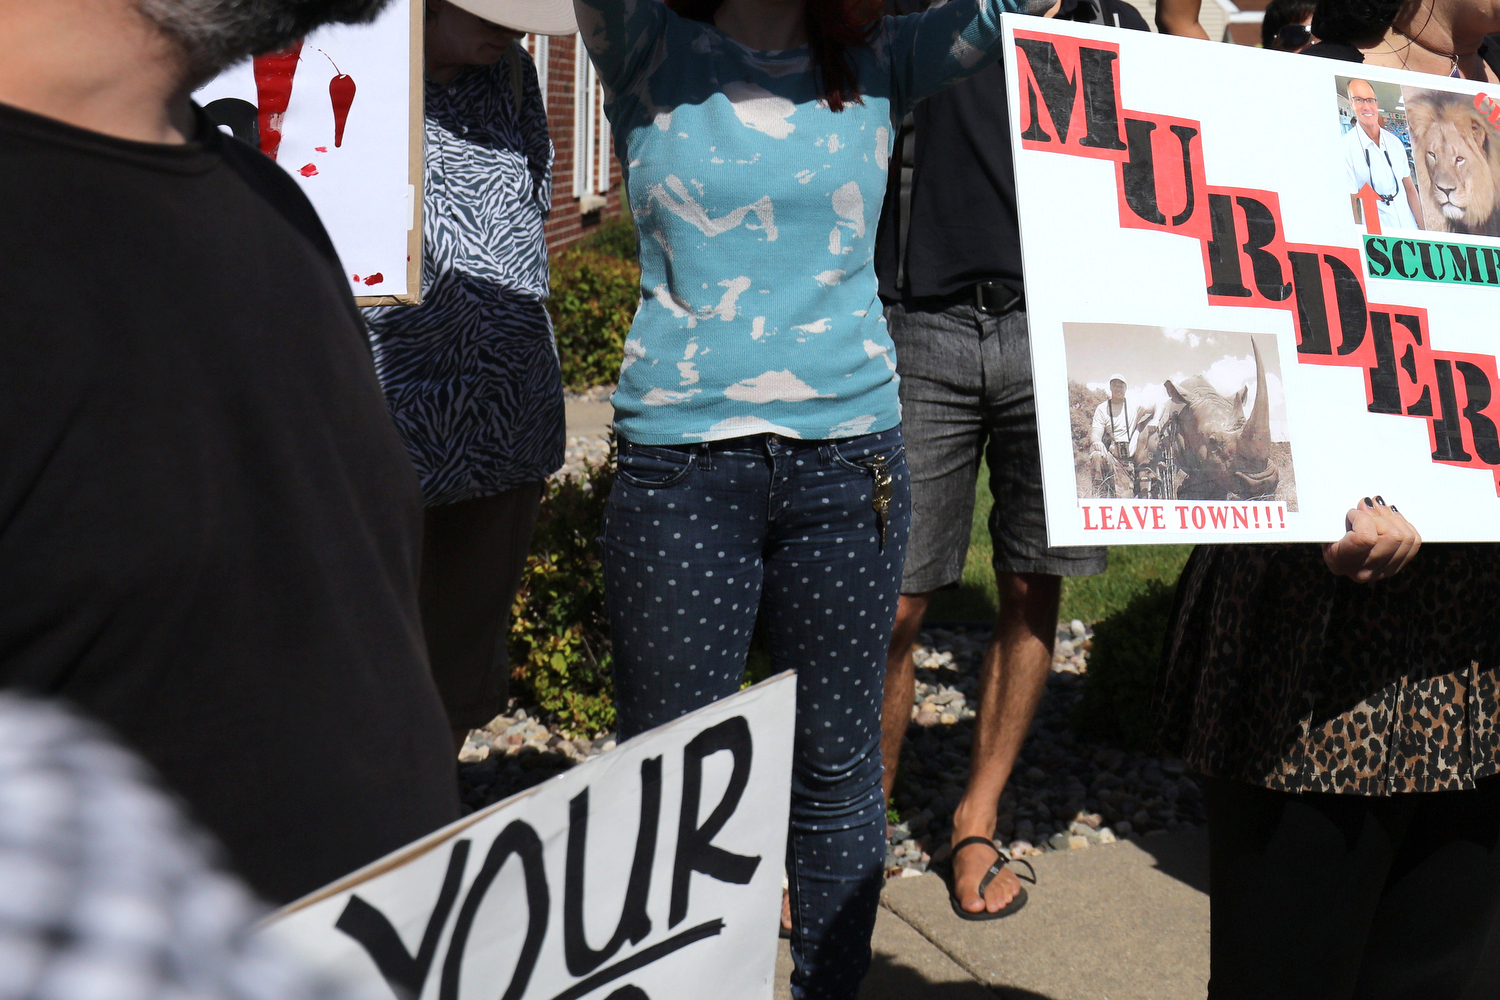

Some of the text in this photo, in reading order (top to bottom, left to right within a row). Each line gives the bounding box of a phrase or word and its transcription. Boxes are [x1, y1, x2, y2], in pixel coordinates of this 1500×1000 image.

[1082, 505, 1285, 530] LEAVE TOWN!!!
[334, 715, 763, 1000] YOUR
